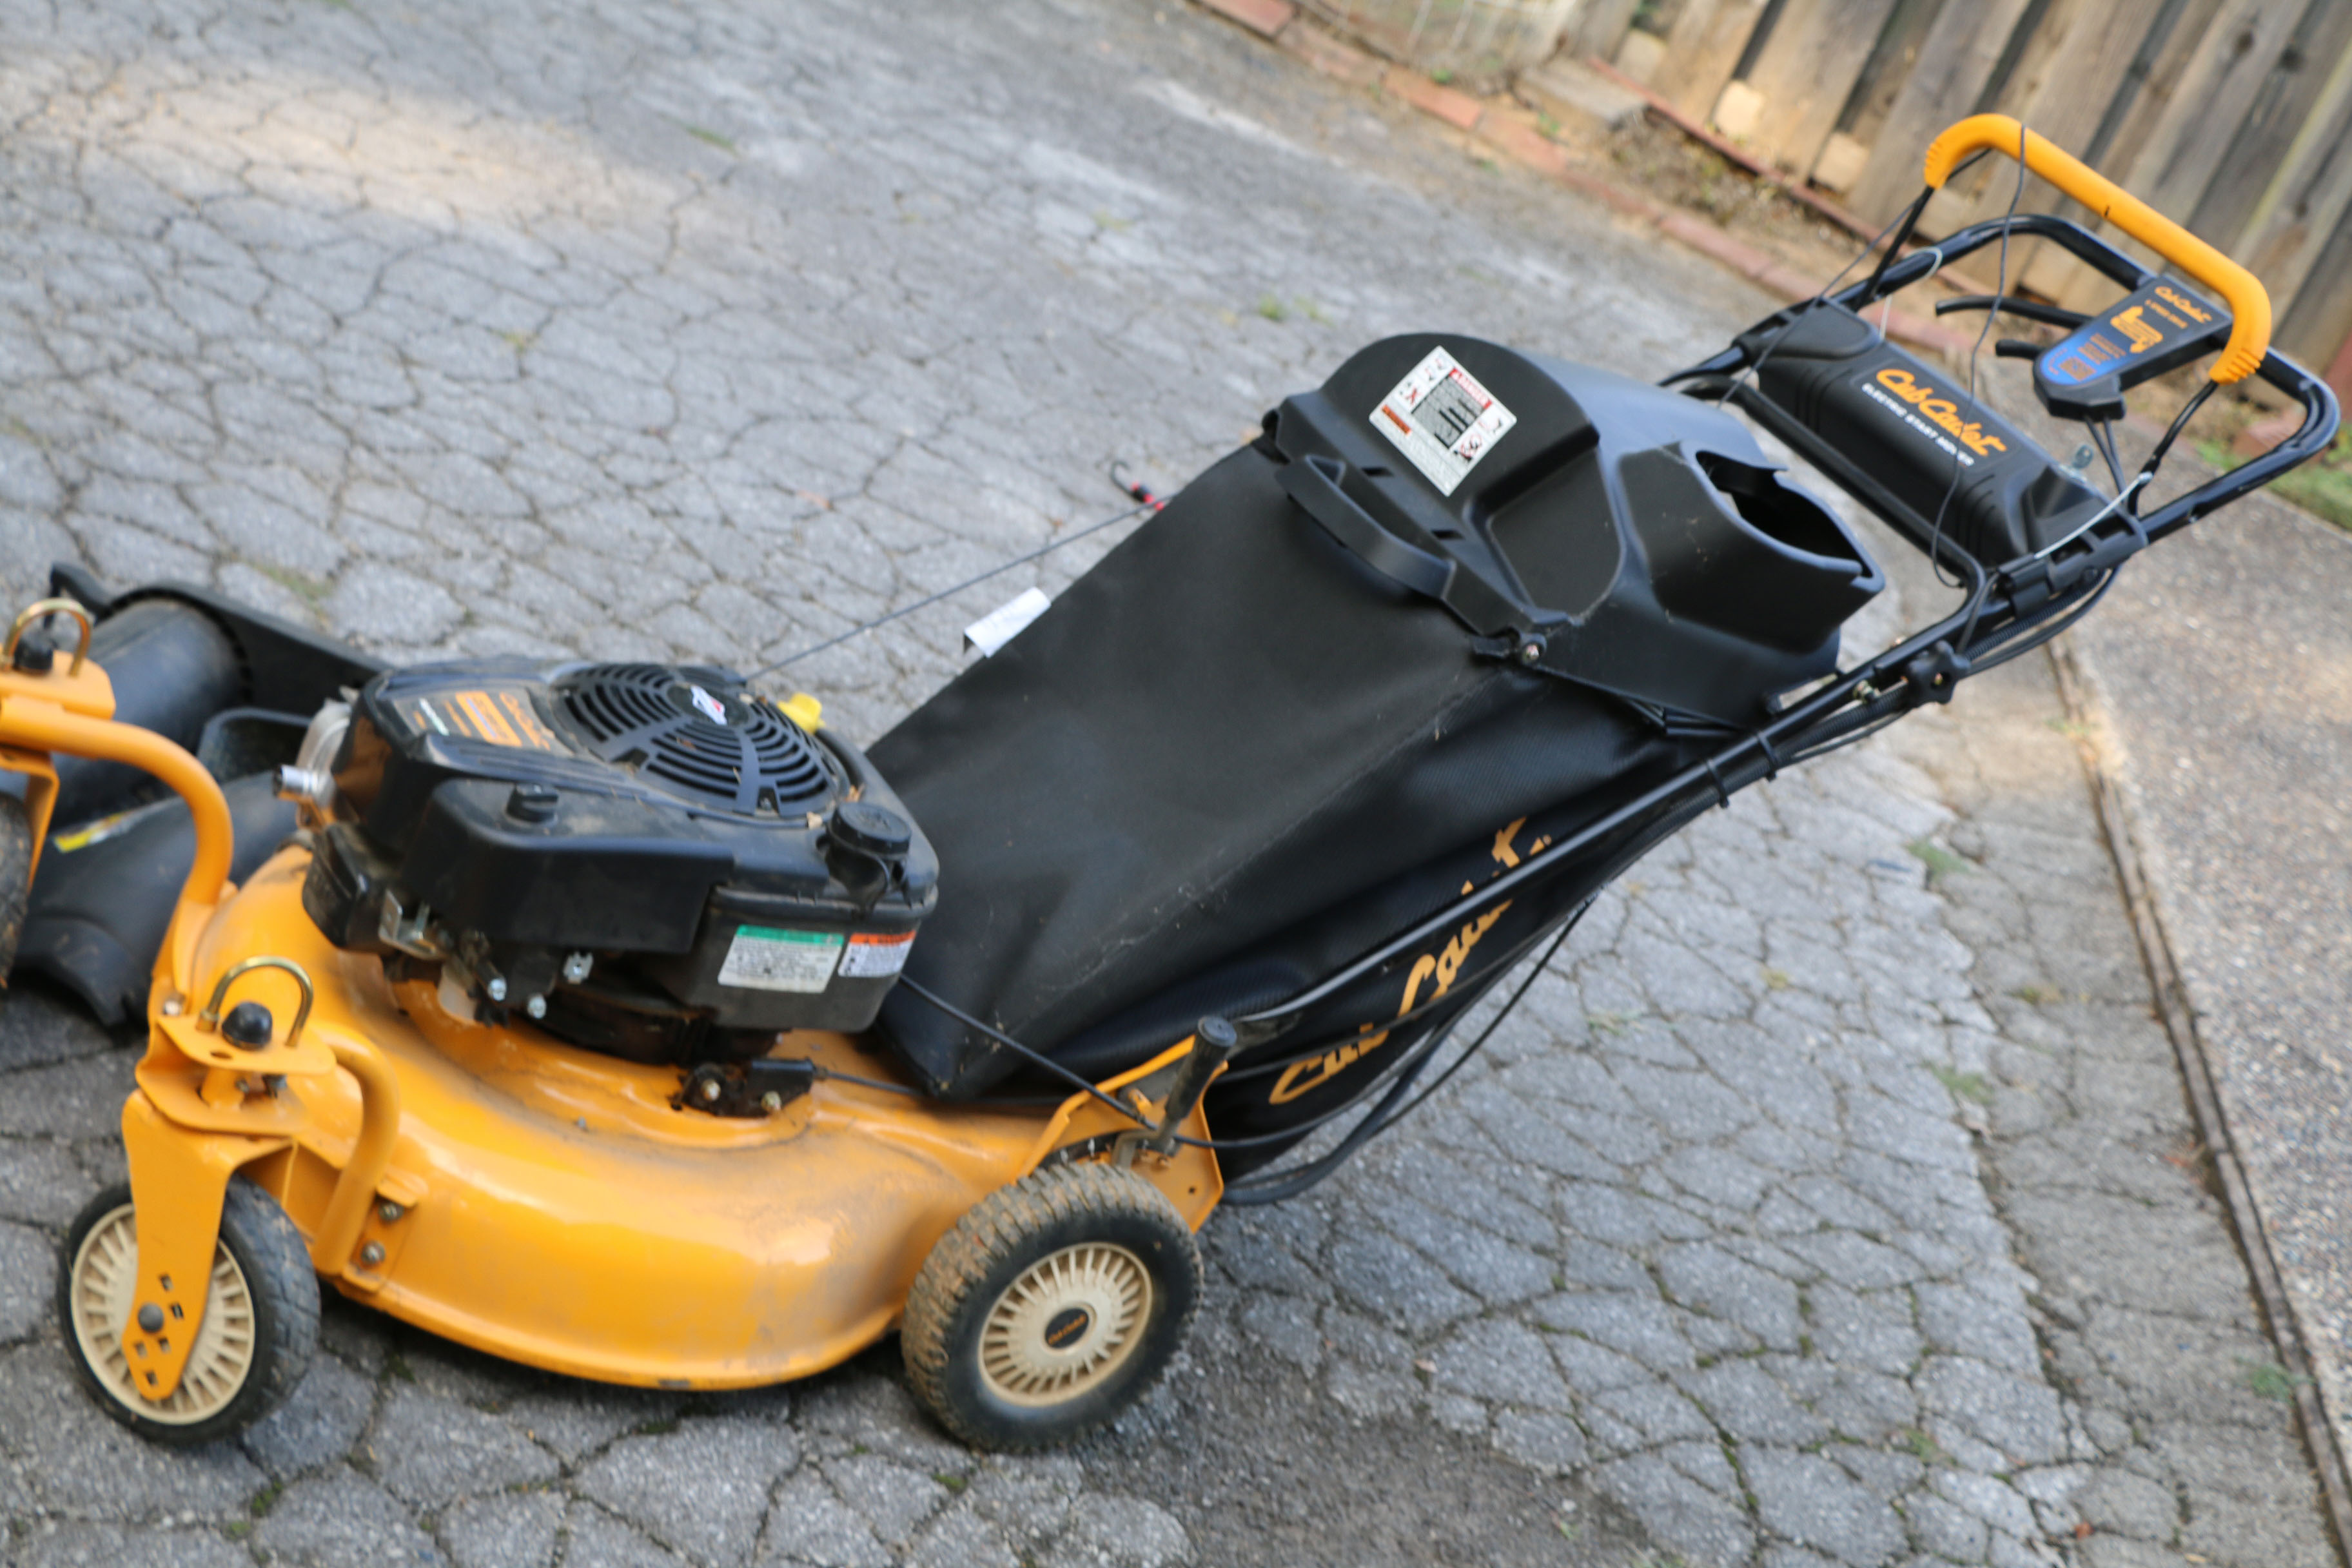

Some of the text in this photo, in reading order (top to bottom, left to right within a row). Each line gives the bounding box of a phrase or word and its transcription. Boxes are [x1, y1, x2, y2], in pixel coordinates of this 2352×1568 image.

[1861, 382, 1908, 418] ELECTRIC
[1905, 413, 1939, 439] START
[1877, 369, 2006, 456] Cub Cadet
